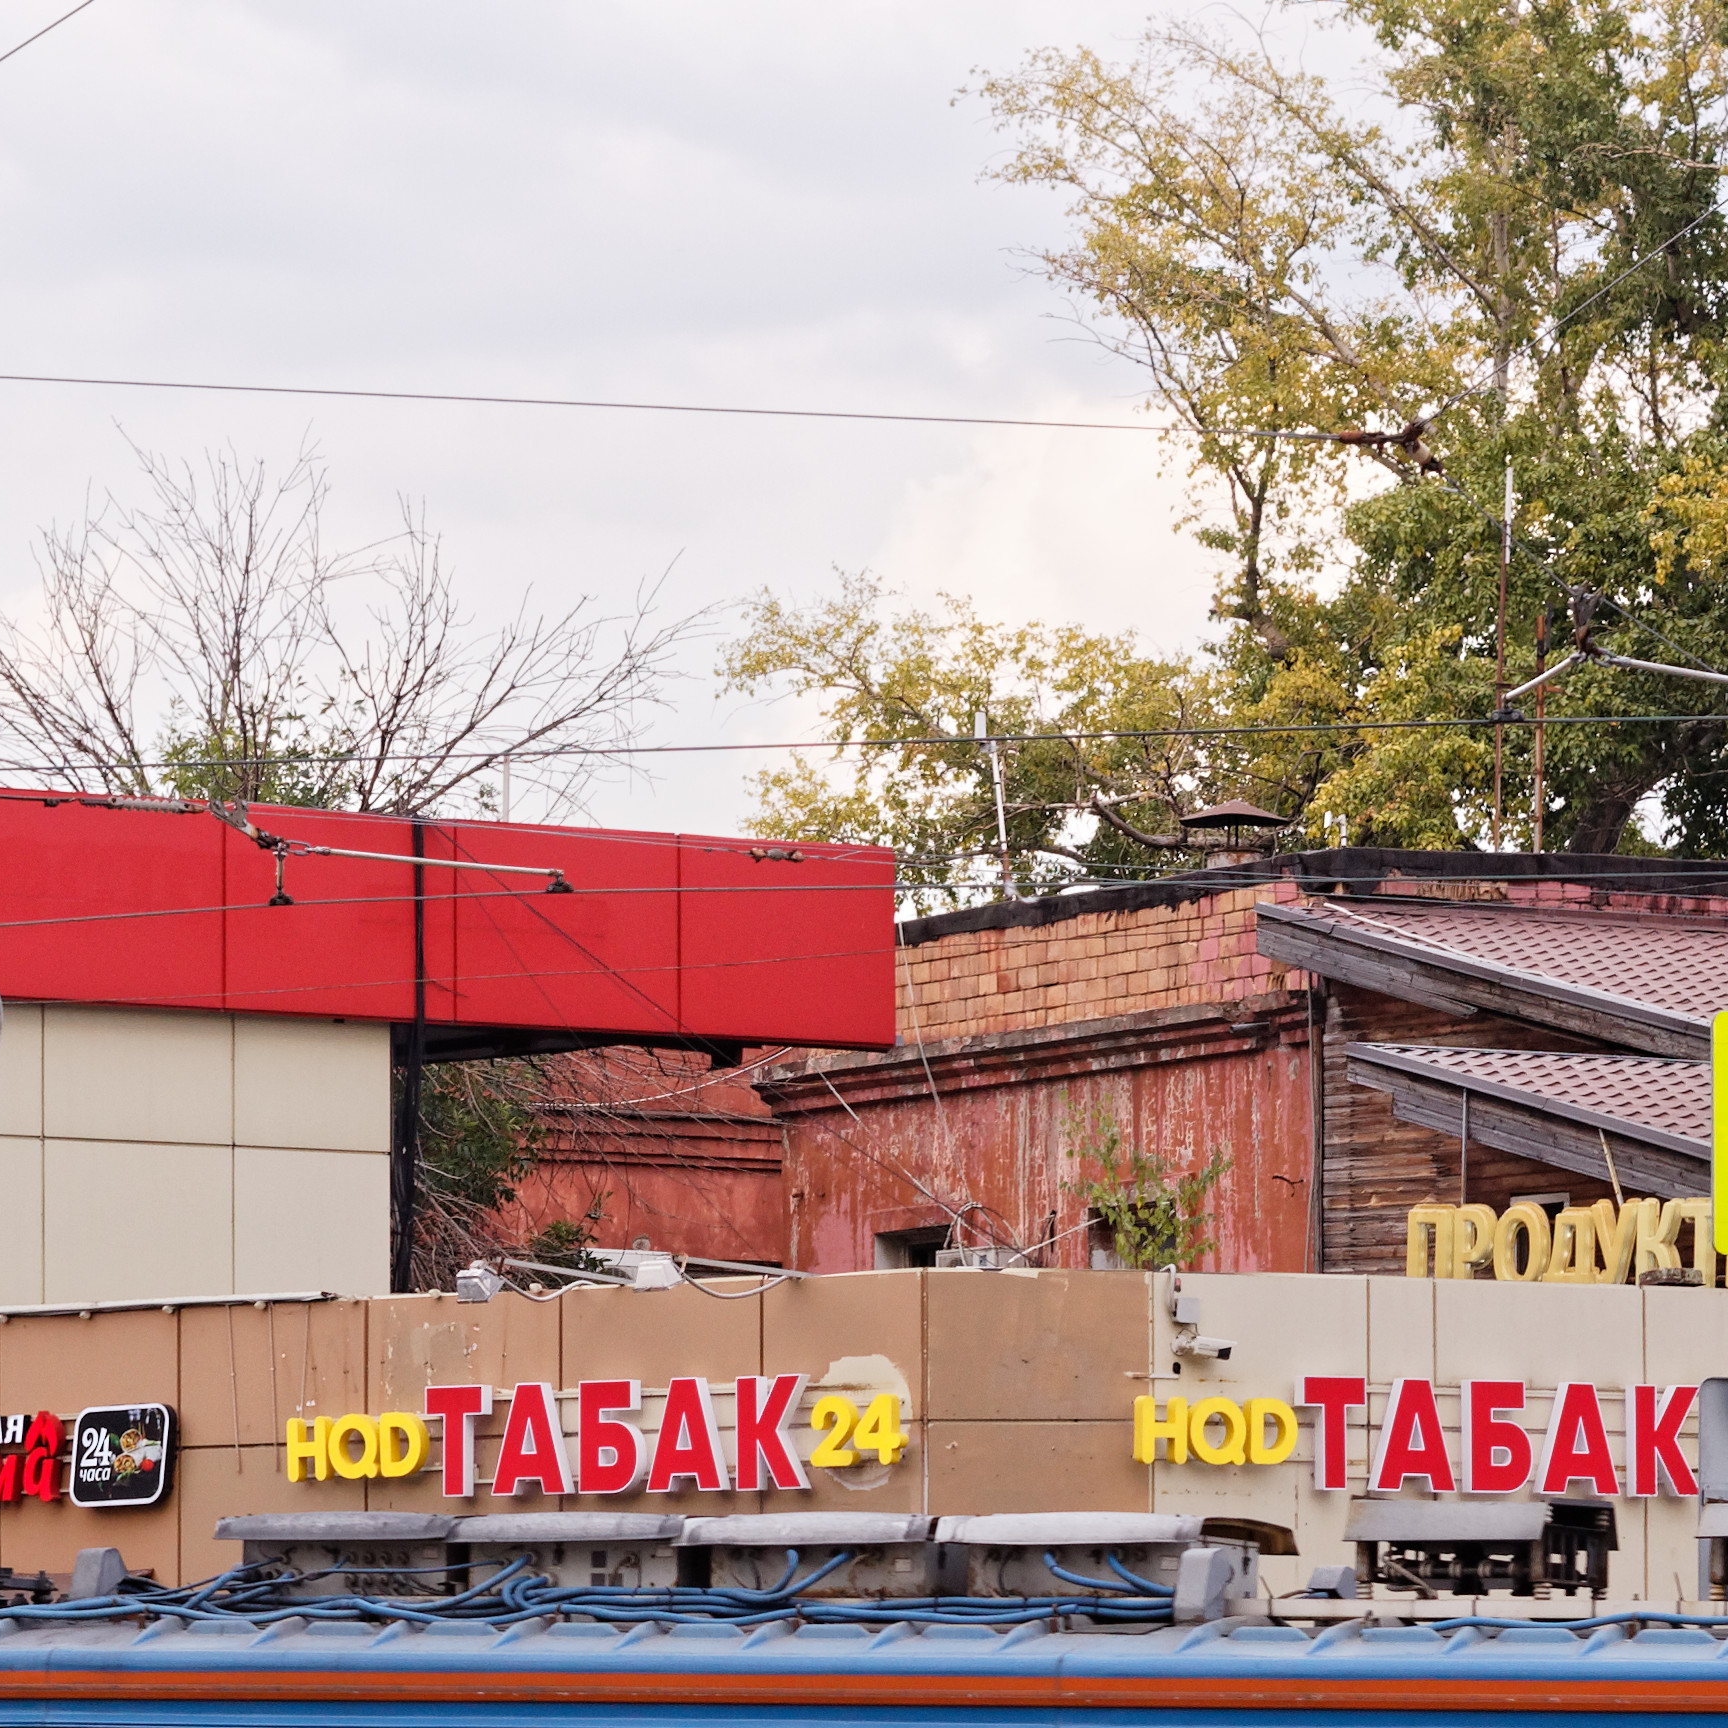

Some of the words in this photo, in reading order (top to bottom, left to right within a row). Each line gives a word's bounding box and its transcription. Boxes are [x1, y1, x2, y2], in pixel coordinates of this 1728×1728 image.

[79, 1427, 115, 1468] 24
[79, 1465, 111, 1483] часа
[286, 1411, 429, 1483] HQD
[424, 1373, 812, 1498] ТАБАК
[810, 1393, 909, 1468] 24
[1133, 1394, 1299, 1466] HQD
[1295, 1375, 1699, 1498] ТАБАК
